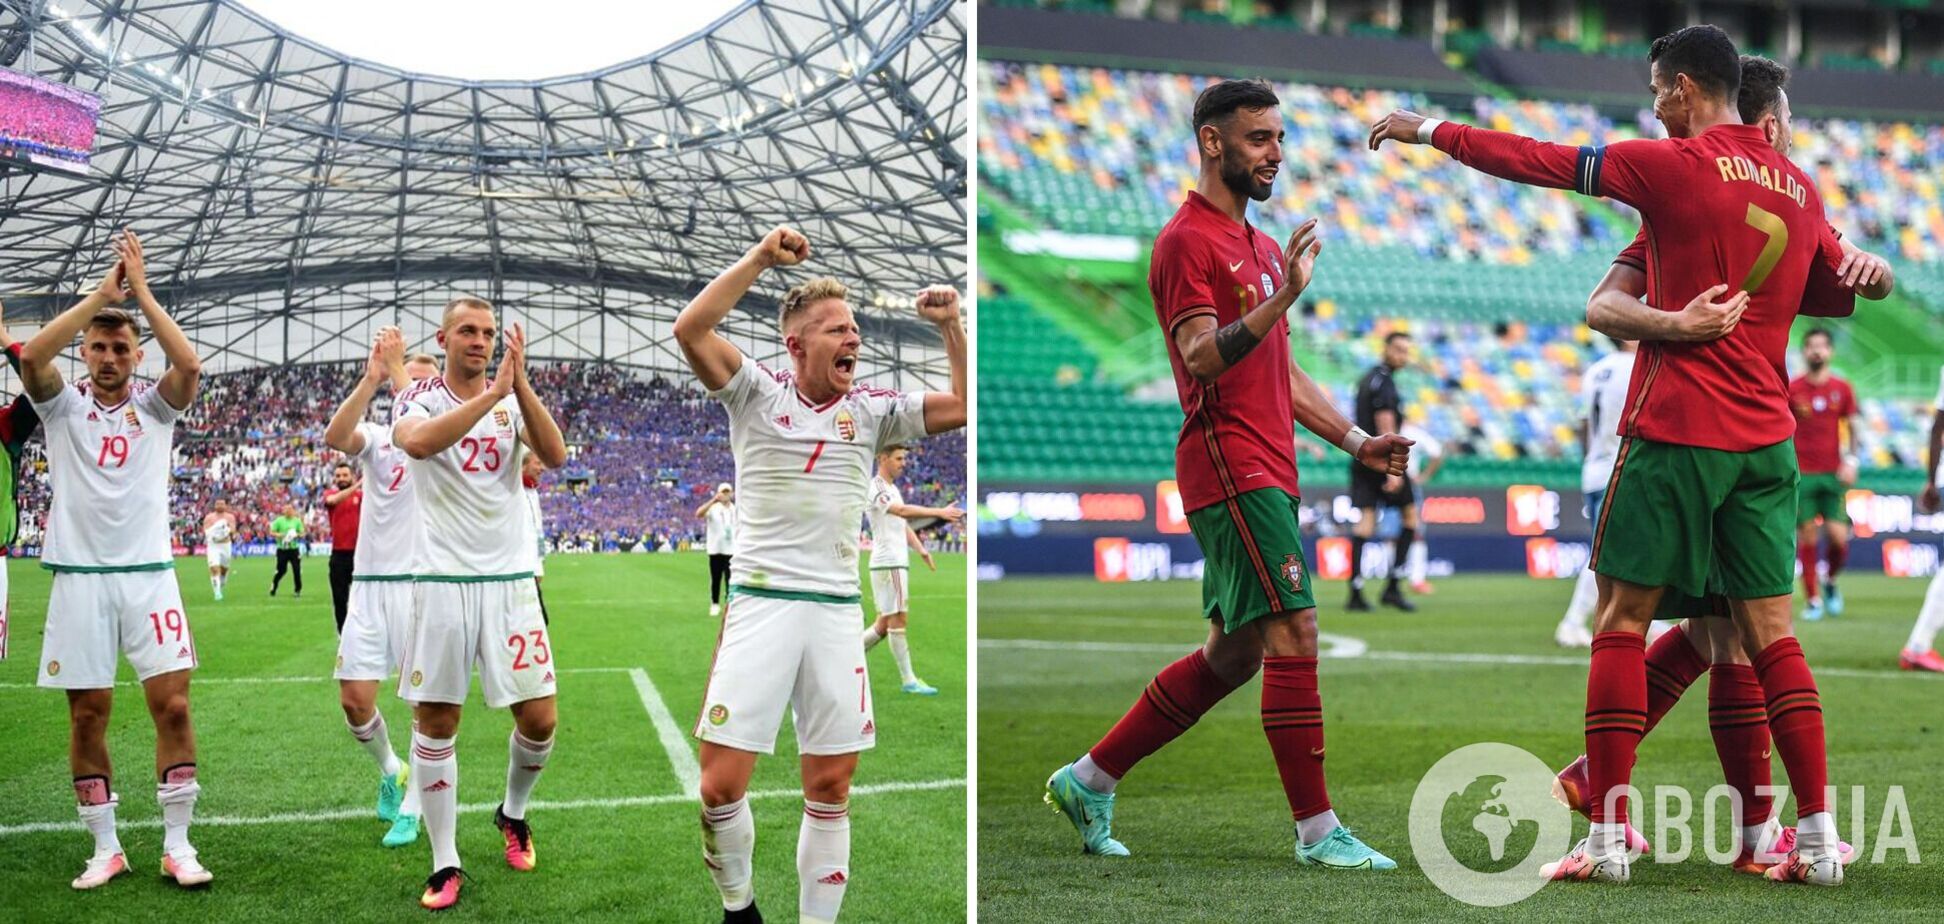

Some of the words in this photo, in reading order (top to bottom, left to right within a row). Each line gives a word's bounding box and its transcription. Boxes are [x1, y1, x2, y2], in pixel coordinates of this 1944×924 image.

[1714, 155, 1808, 209] RONALDO
[1740, 202, 1789, 294] 7
[98, 435, 128, 468] 19
[460, 436, 500, 472] 23
[150, 609, 182, 645] 19
[508, 629, 549, 671] 23
[855, 667, 866, 713] 7
